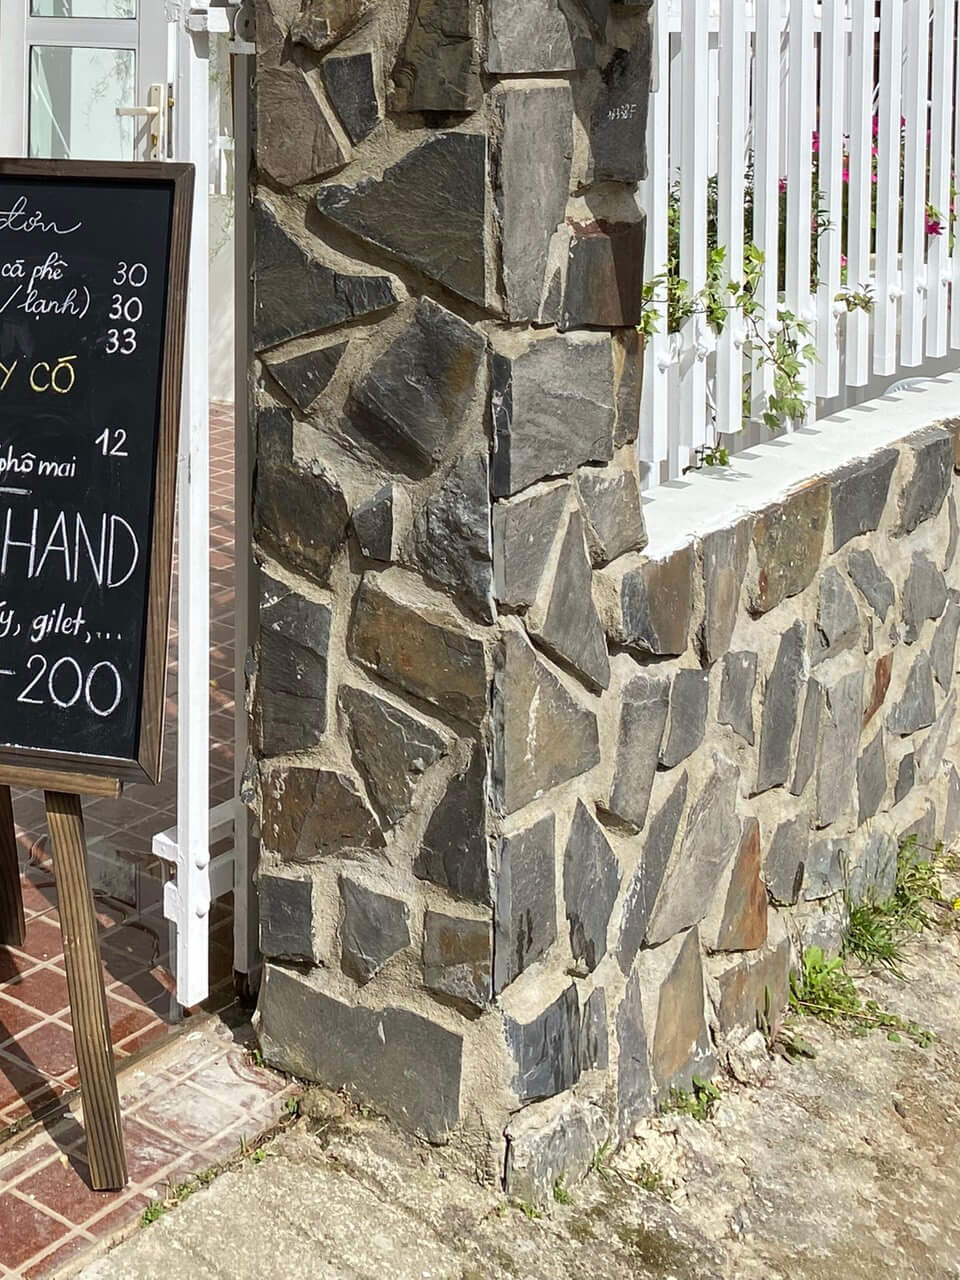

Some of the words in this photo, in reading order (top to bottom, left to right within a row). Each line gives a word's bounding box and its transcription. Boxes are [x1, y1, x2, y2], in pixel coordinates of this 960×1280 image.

[27, 252, 68, 293] phê
[112, 261, 148, 287] 30
[109, 294, 143, 322] 30
[105, 328, 137, 354] 33
[95, 428, 128, 456] 12
[38, 456, 76, 477] mai
